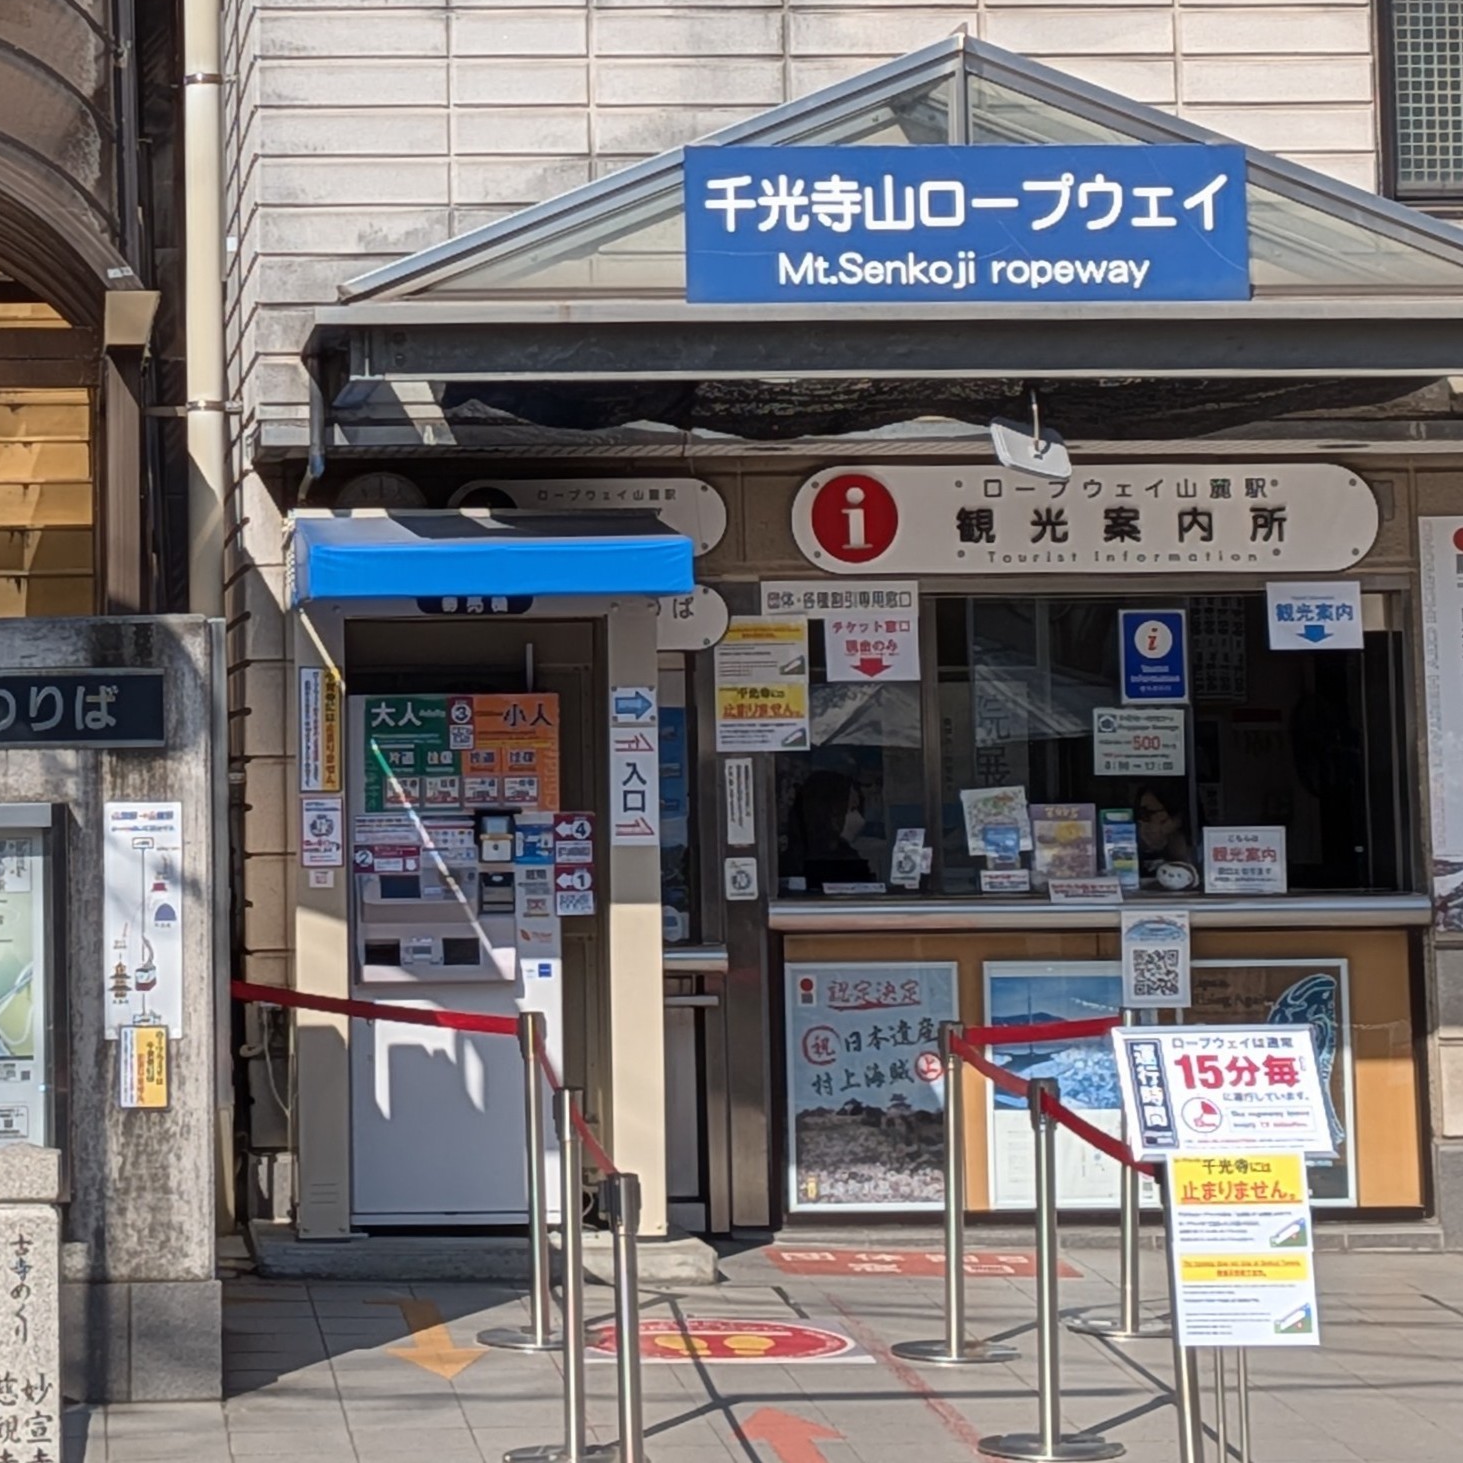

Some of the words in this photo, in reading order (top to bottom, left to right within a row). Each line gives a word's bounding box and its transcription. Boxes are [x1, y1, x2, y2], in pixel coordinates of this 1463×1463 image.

[704, 172, 1228, 233] 千光寺山ロープウェイ
[778, 251, 976, 290] Mt.Senkoji
[991, 257, 1150, 290] ropeway
[956, 506, 1288, 544] 観光案内所
[988, 549, 1079, 563] Tourist
[1093, 548, 1259, 563] Information
[1276, 603, 1354, 622] 観光案内
[371, 701, 422, 727] 大人
[453, 706, 469, 722] 3
[503, 703, 553, 727] 小人
[1133, 735, 1161, 751] 500
[622, 762, 647, 813] 入口
[576, 822, 587, 836] 4
[577, 874, 586, 887] 1
[844, 1017, 938, 1053] 日本遺産
[812, 1059, 915, 1096] 村上海賊
[1174, 1054, 1302, 1090] 15分毎
[1202, 1158, 1272, 1175] 千光寺には
[1182, 1180, 1296, 1200] 止まりません。
